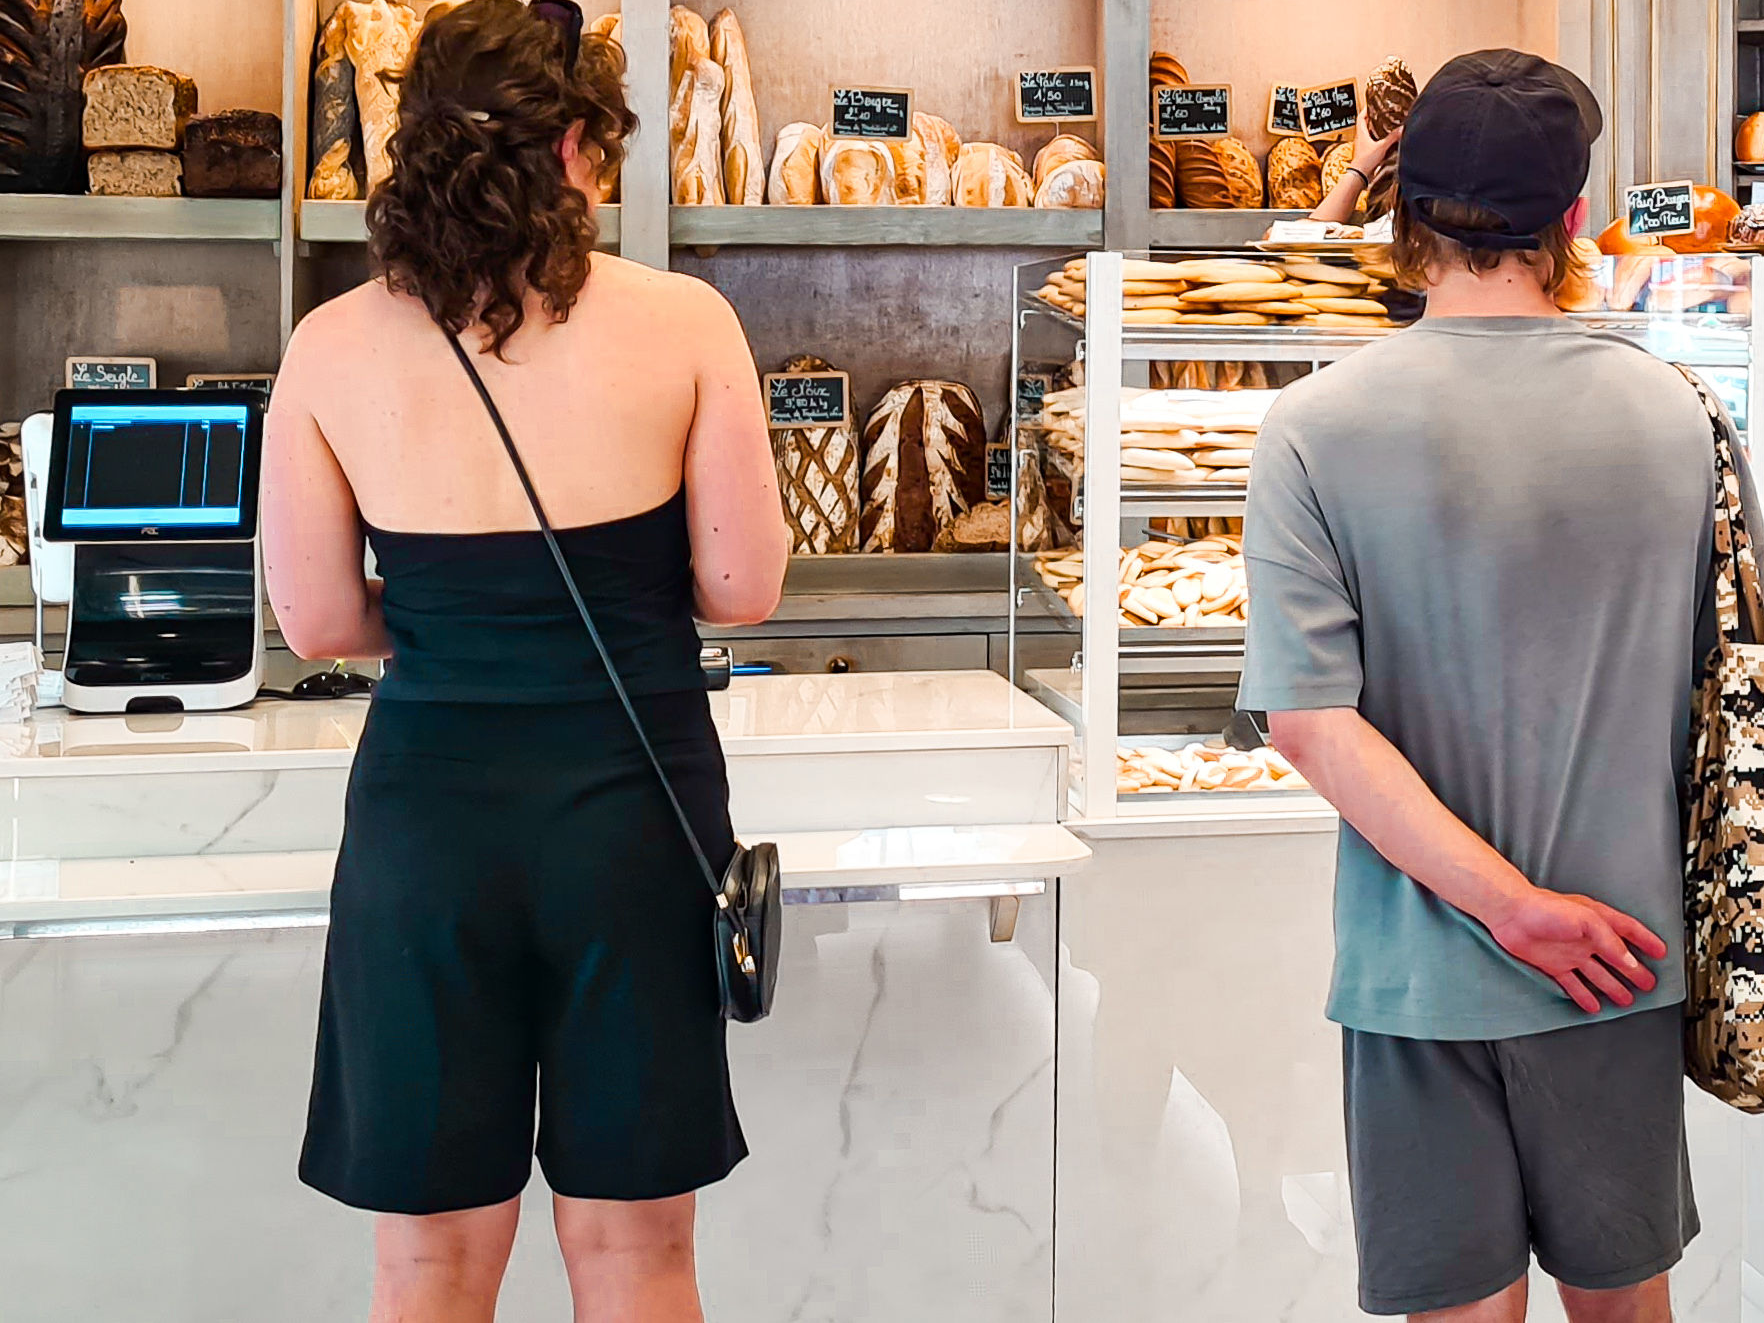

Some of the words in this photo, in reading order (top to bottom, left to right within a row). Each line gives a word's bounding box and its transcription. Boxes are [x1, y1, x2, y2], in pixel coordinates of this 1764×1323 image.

[1021, 71, 1037, 89] Le
[834, 89, 849, 106] Le
[1158, 89, 1172, 105] Le
[1629, 190, 1660, 212] Pain
[73, 363, 92, 382] Le
[96, 364, 145, 385] Seigle
[771, 378, 788, 397] Le
